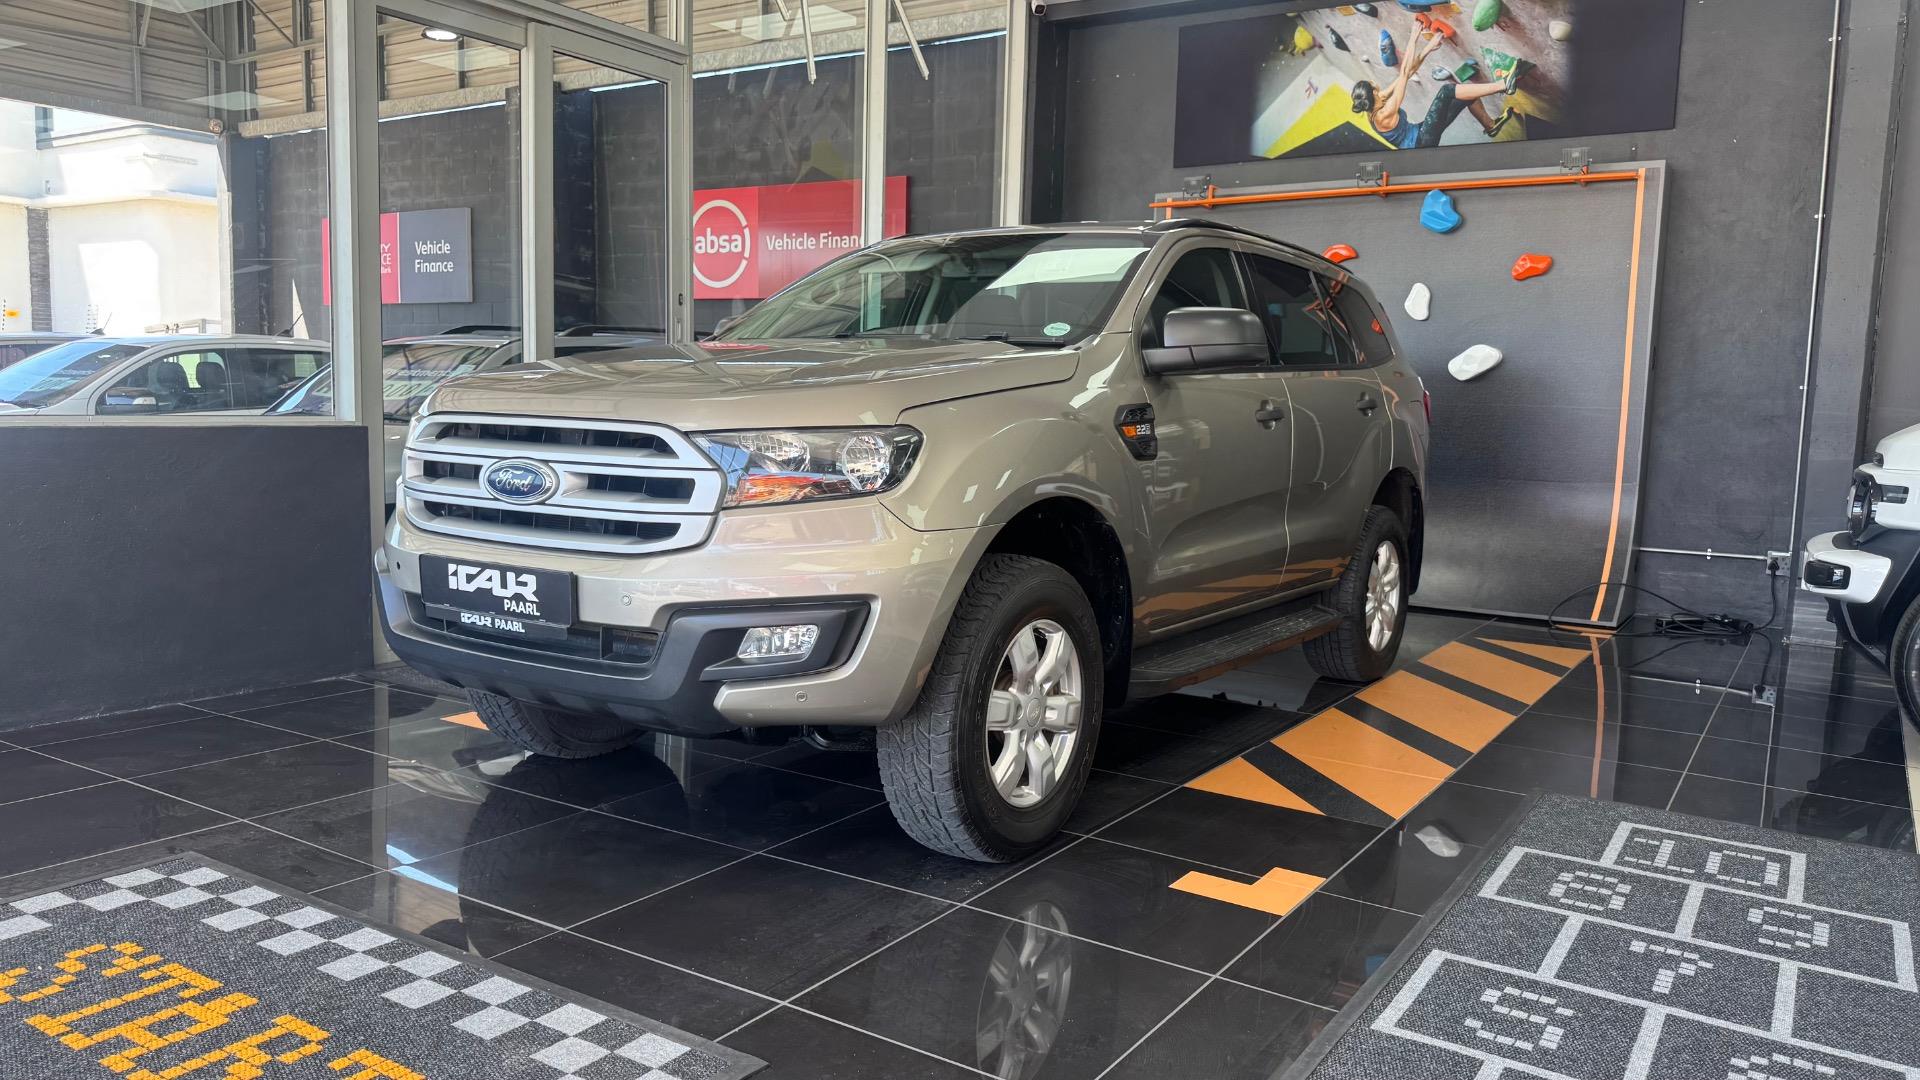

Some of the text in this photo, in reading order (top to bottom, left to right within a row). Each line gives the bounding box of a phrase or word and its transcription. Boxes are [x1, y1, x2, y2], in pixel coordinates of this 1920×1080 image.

[414, 240, 451, 255] Vehicle
[694, 227, 743, 254] absa
[766, 232, 816, 250] Vehicle
[414, 259, 454, 273] Finance
[496, 468, 533, 492] Ford
[504, 598, 541, 616] PAARL
[494, 618, 526, 633] PAARL
[1747, 906, 1829, 949] 9
[1629, 940, 1714, 994] 7
